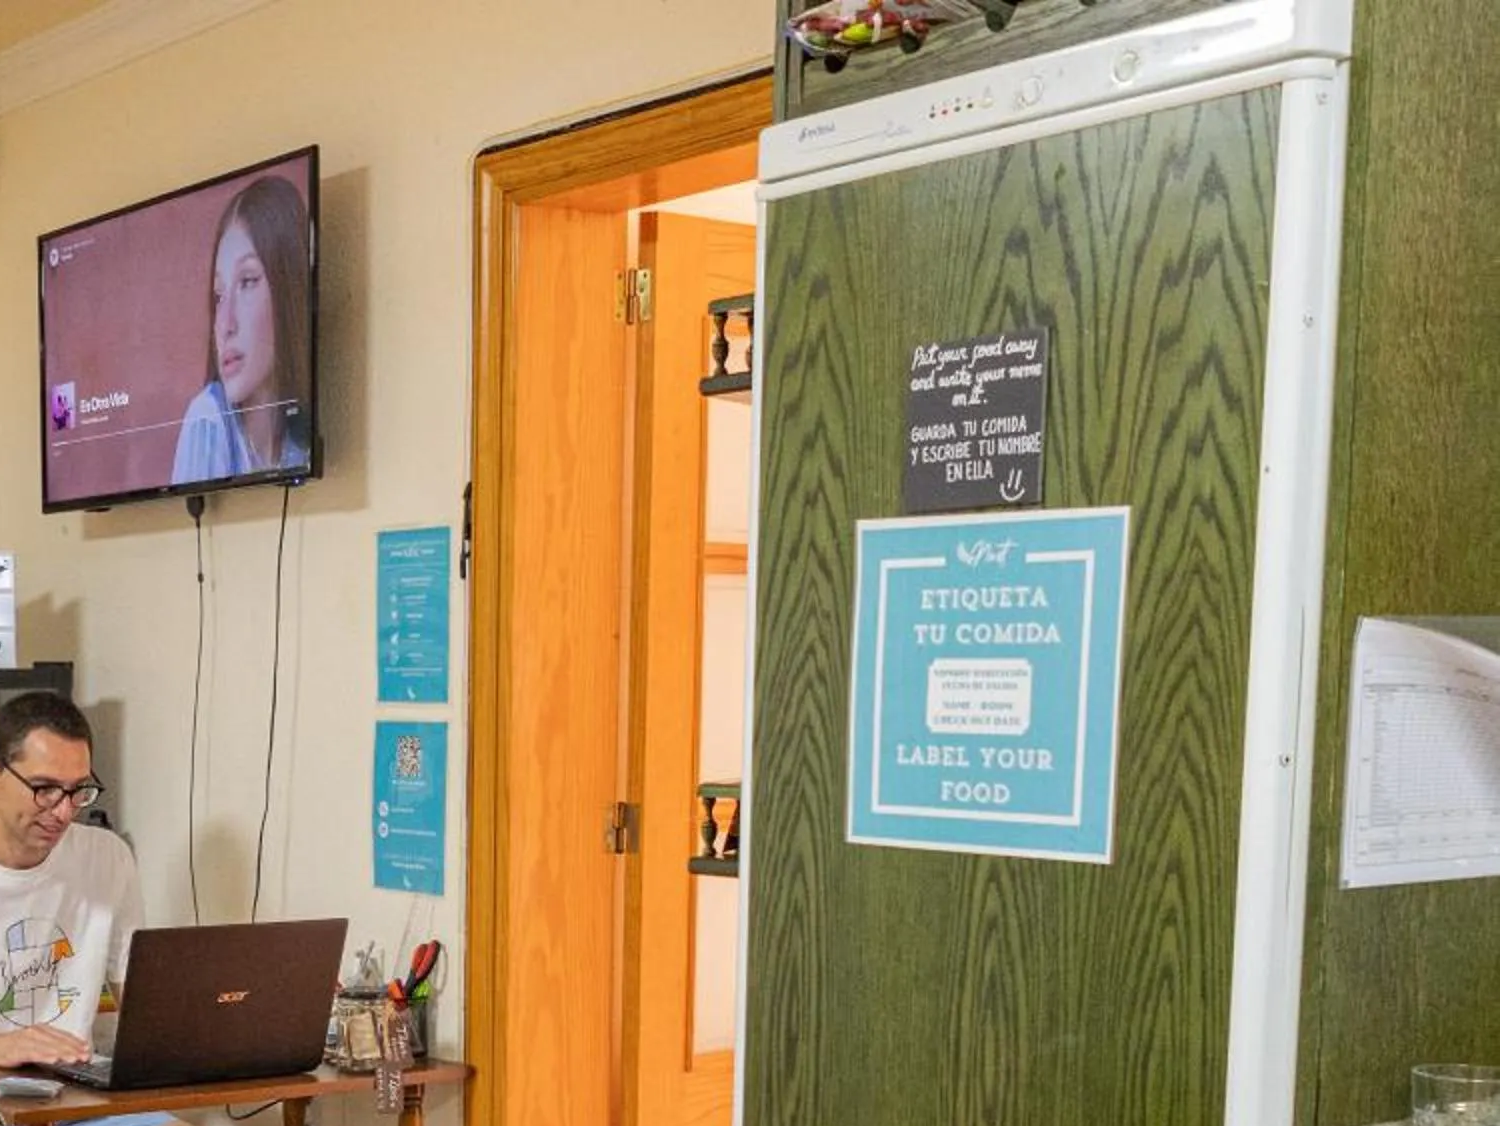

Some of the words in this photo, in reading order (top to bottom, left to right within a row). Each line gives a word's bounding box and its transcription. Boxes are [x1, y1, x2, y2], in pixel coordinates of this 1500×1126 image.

[911, 369, 935, 391] and
[938, 367, 972, 388] write
[975, 367, 1006, 388] your
[911, 422, 957, 443] GUARDA
[962, 420, 977, 437] TU
[981, 415, 1027, 436] COMIDA
[911, 448, 919, 466] Y
[922, 441, 972, 464] ESCRIBE
[978, 438, 995, 457] TU
[998, 431, 1042, 456] NOMBRE
[946, 463, 963, 483] EN
[966, 459, 994, 481] ELLA
[921, 586, 1048, 612] ETIQUETA
[913, 623, 947, 645] TU
[955, 622, 1062, 645] COMIDA
[896, 743, 971, 768] LABEL
[980, 746, 1055, 771] YOUR
[940, 780, 1011, 804] FOOD
